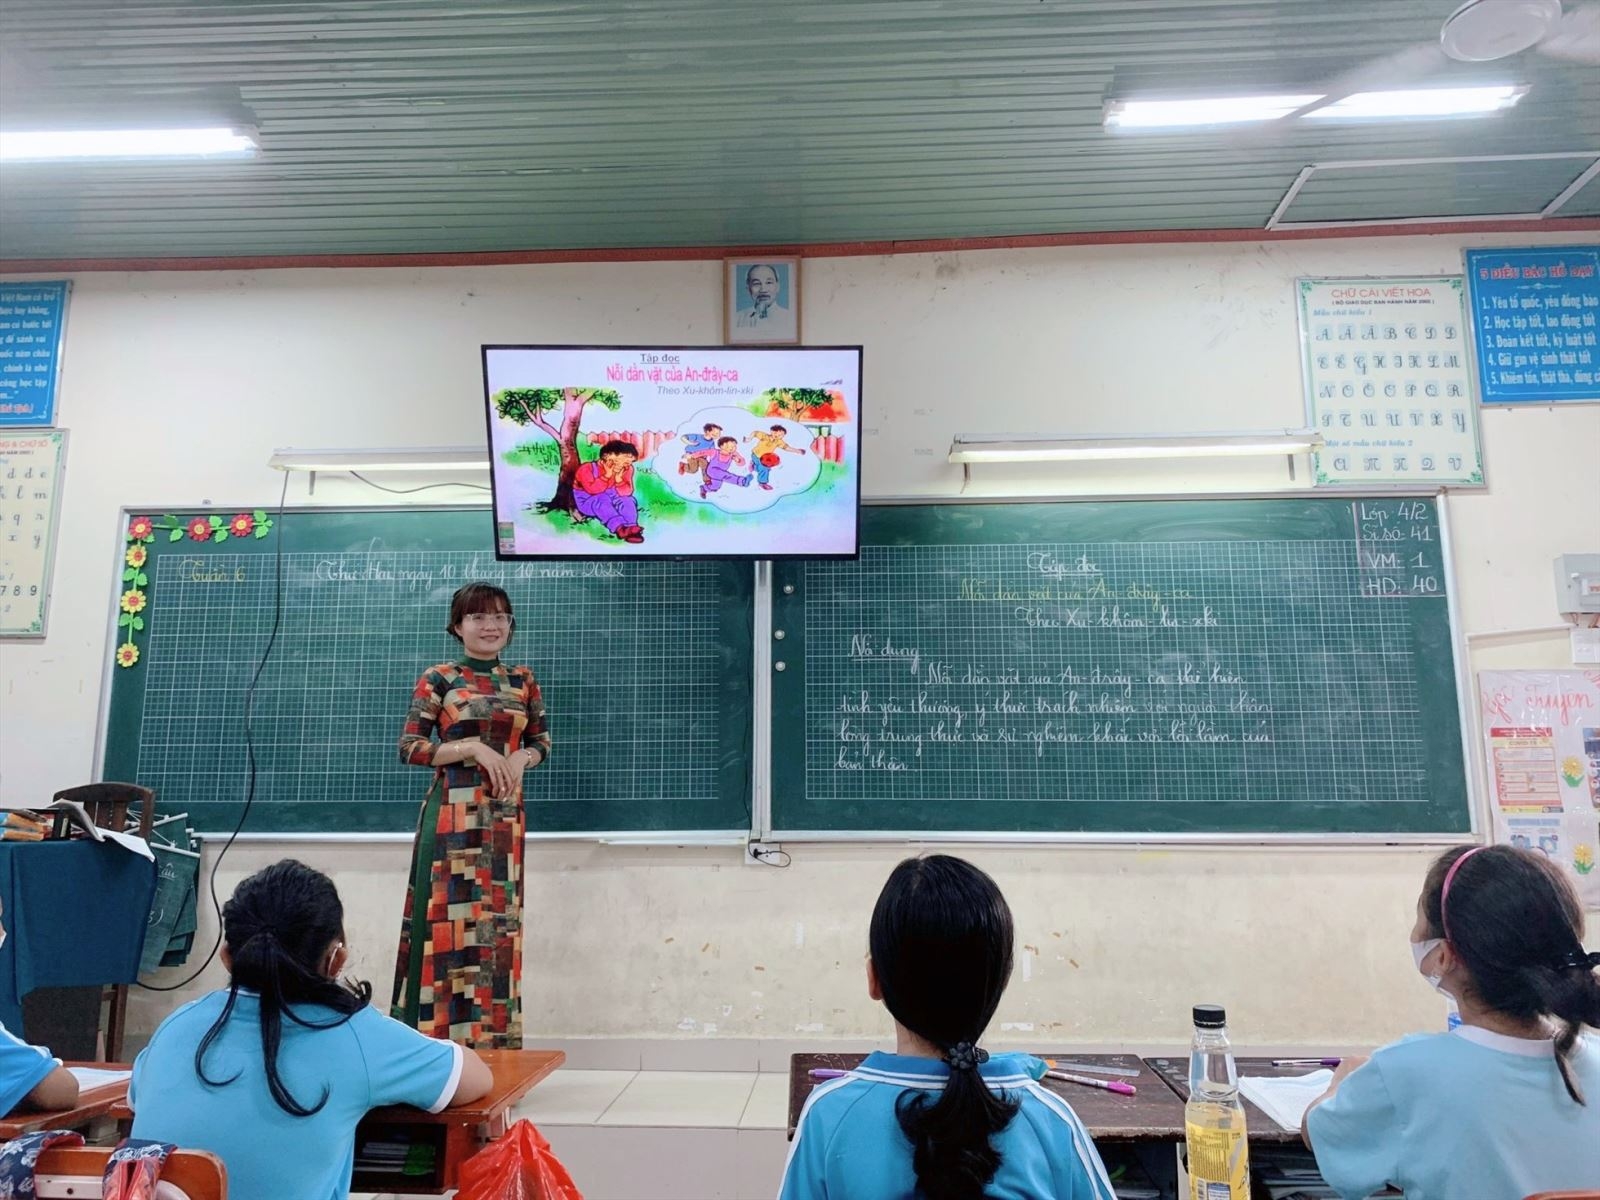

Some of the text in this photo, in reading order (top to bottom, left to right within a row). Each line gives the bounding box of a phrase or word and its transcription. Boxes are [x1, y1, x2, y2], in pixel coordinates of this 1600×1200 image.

[1331, 286, 1356, 298] CHỮ
[1407, 287, 1431, 297] HOA
[607, 363, 623, 381] Nỗi
[665, 365, 683, 381] của
[657, 386, 680, 395] Theo
[1361, 501, 1428, 527] Lớp 4/2
[1411, 525, 1434, 541] 41
[1410, 551, 1432, 568] 1
[234, 566, 246, 582] 6
[440, 564, 456, 579] 10
[515, 562, 533, 578] 10
[583, 561, 625, 577] 2022
[13, 584, 21, 597] 8
[30, 584, 37, 597] 9
[1413, 574, 1437, 592] 40
[878, 697, 903, 726] yêu
[877, 728, 922, 756] trung
